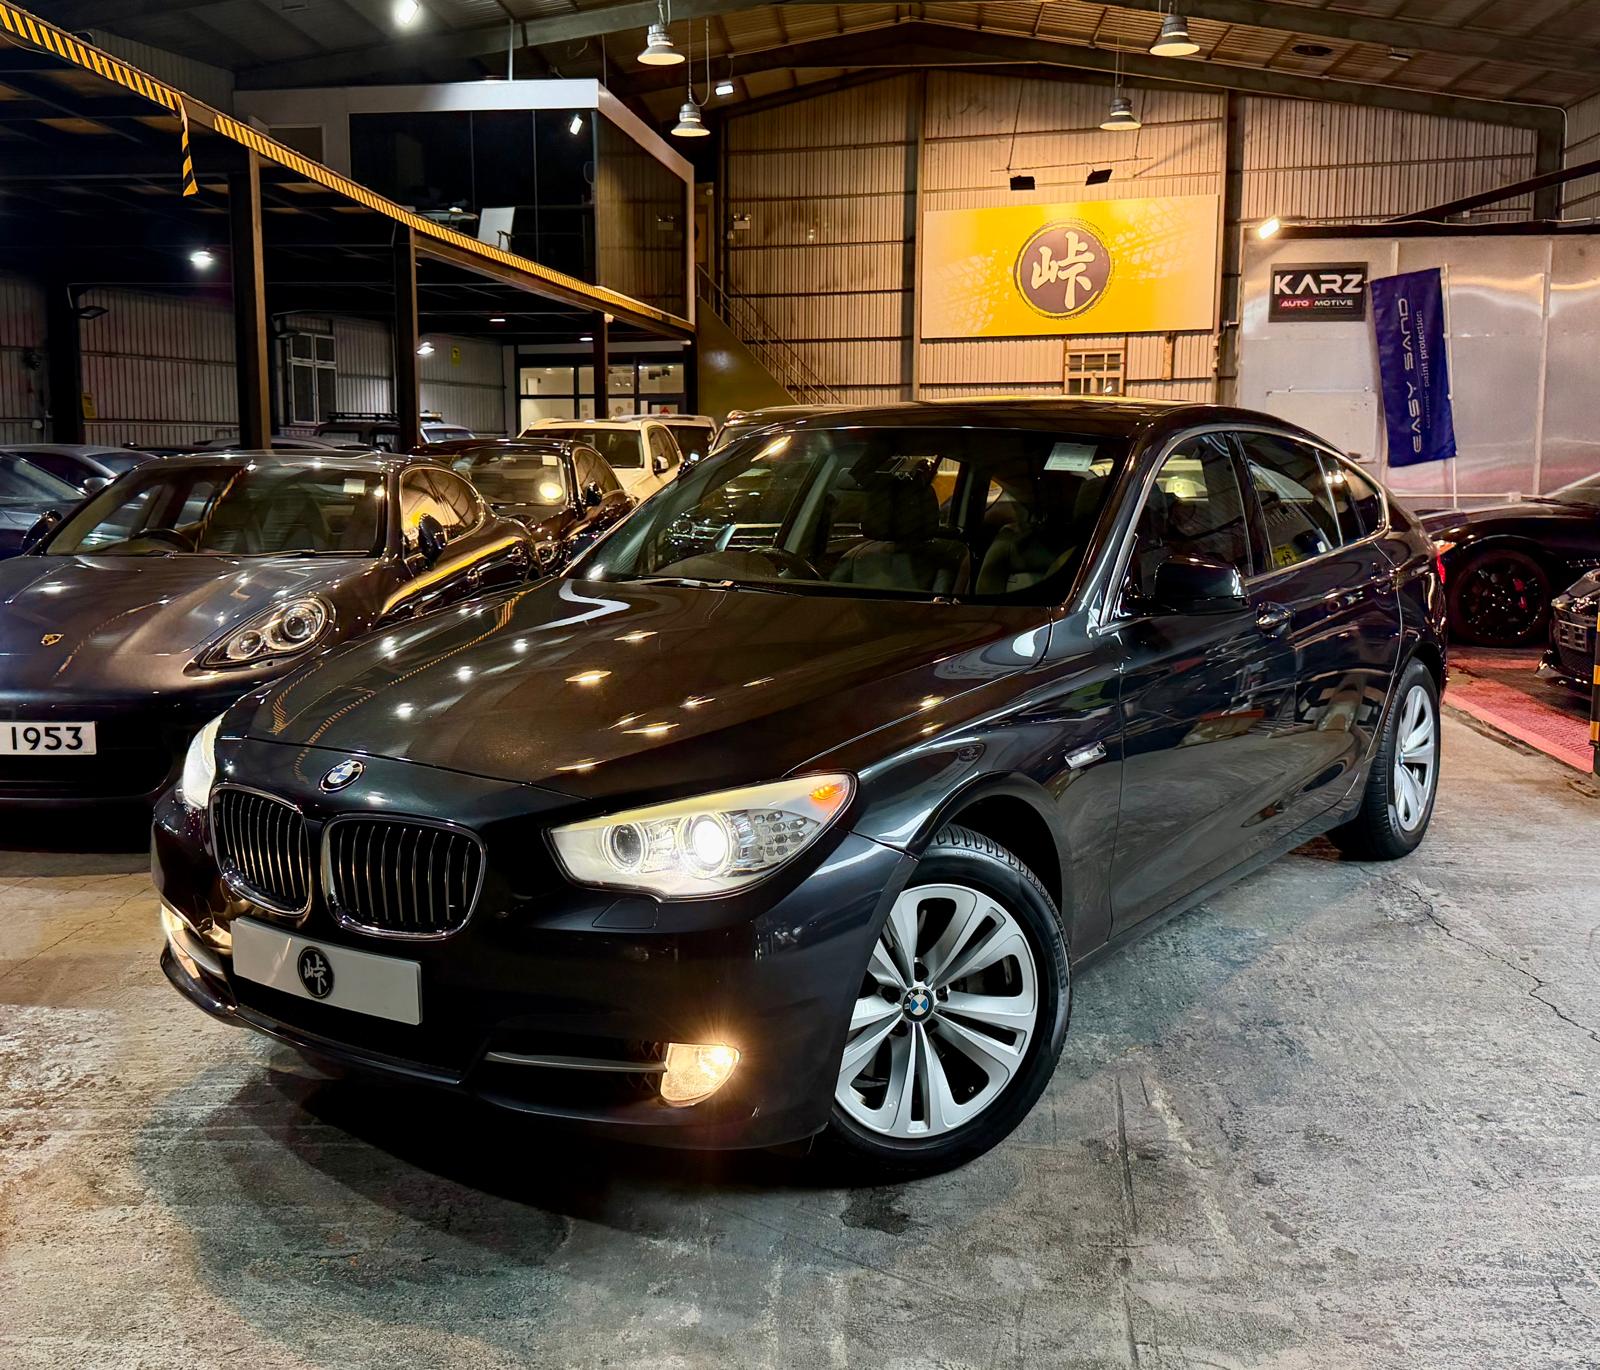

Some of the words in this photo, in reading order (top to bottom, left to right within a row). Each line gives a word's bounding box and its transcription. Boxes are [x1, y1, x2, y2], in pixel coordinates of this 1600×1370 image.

[1031, 231, 1095, 310] 峠
[1274, 274, 1363, 295] KARZ
[1416, 310, 1429, 359] protection
[1406, 381, 1421, 453] EASY
[11, 726, 83, 751] 1953
[304, 953, 327, 994] 峠
